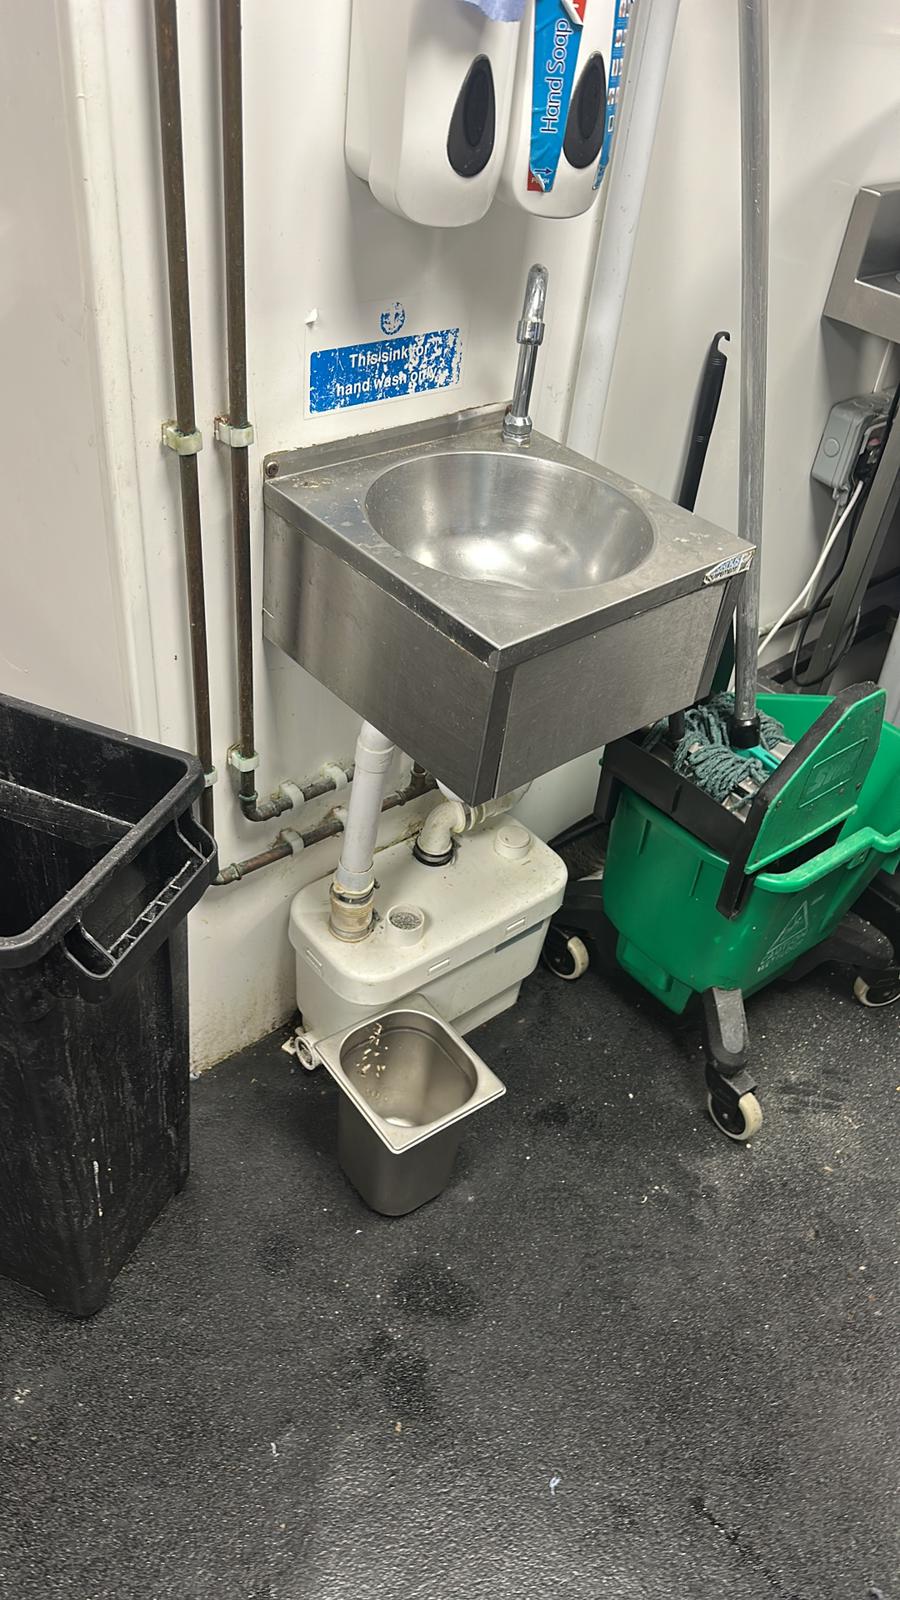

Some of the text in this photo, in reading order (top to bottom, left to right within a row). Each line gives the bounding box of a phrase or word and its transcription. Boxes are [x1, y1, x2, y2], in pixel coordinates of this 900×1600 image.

[540, 19, 572, 133] Hand Soap
[349, 352, 378, 368] This
[381, 346, 408, 363] sink
[335, 380, 370, 397] hand
[373, 371, 407, 389] wash
